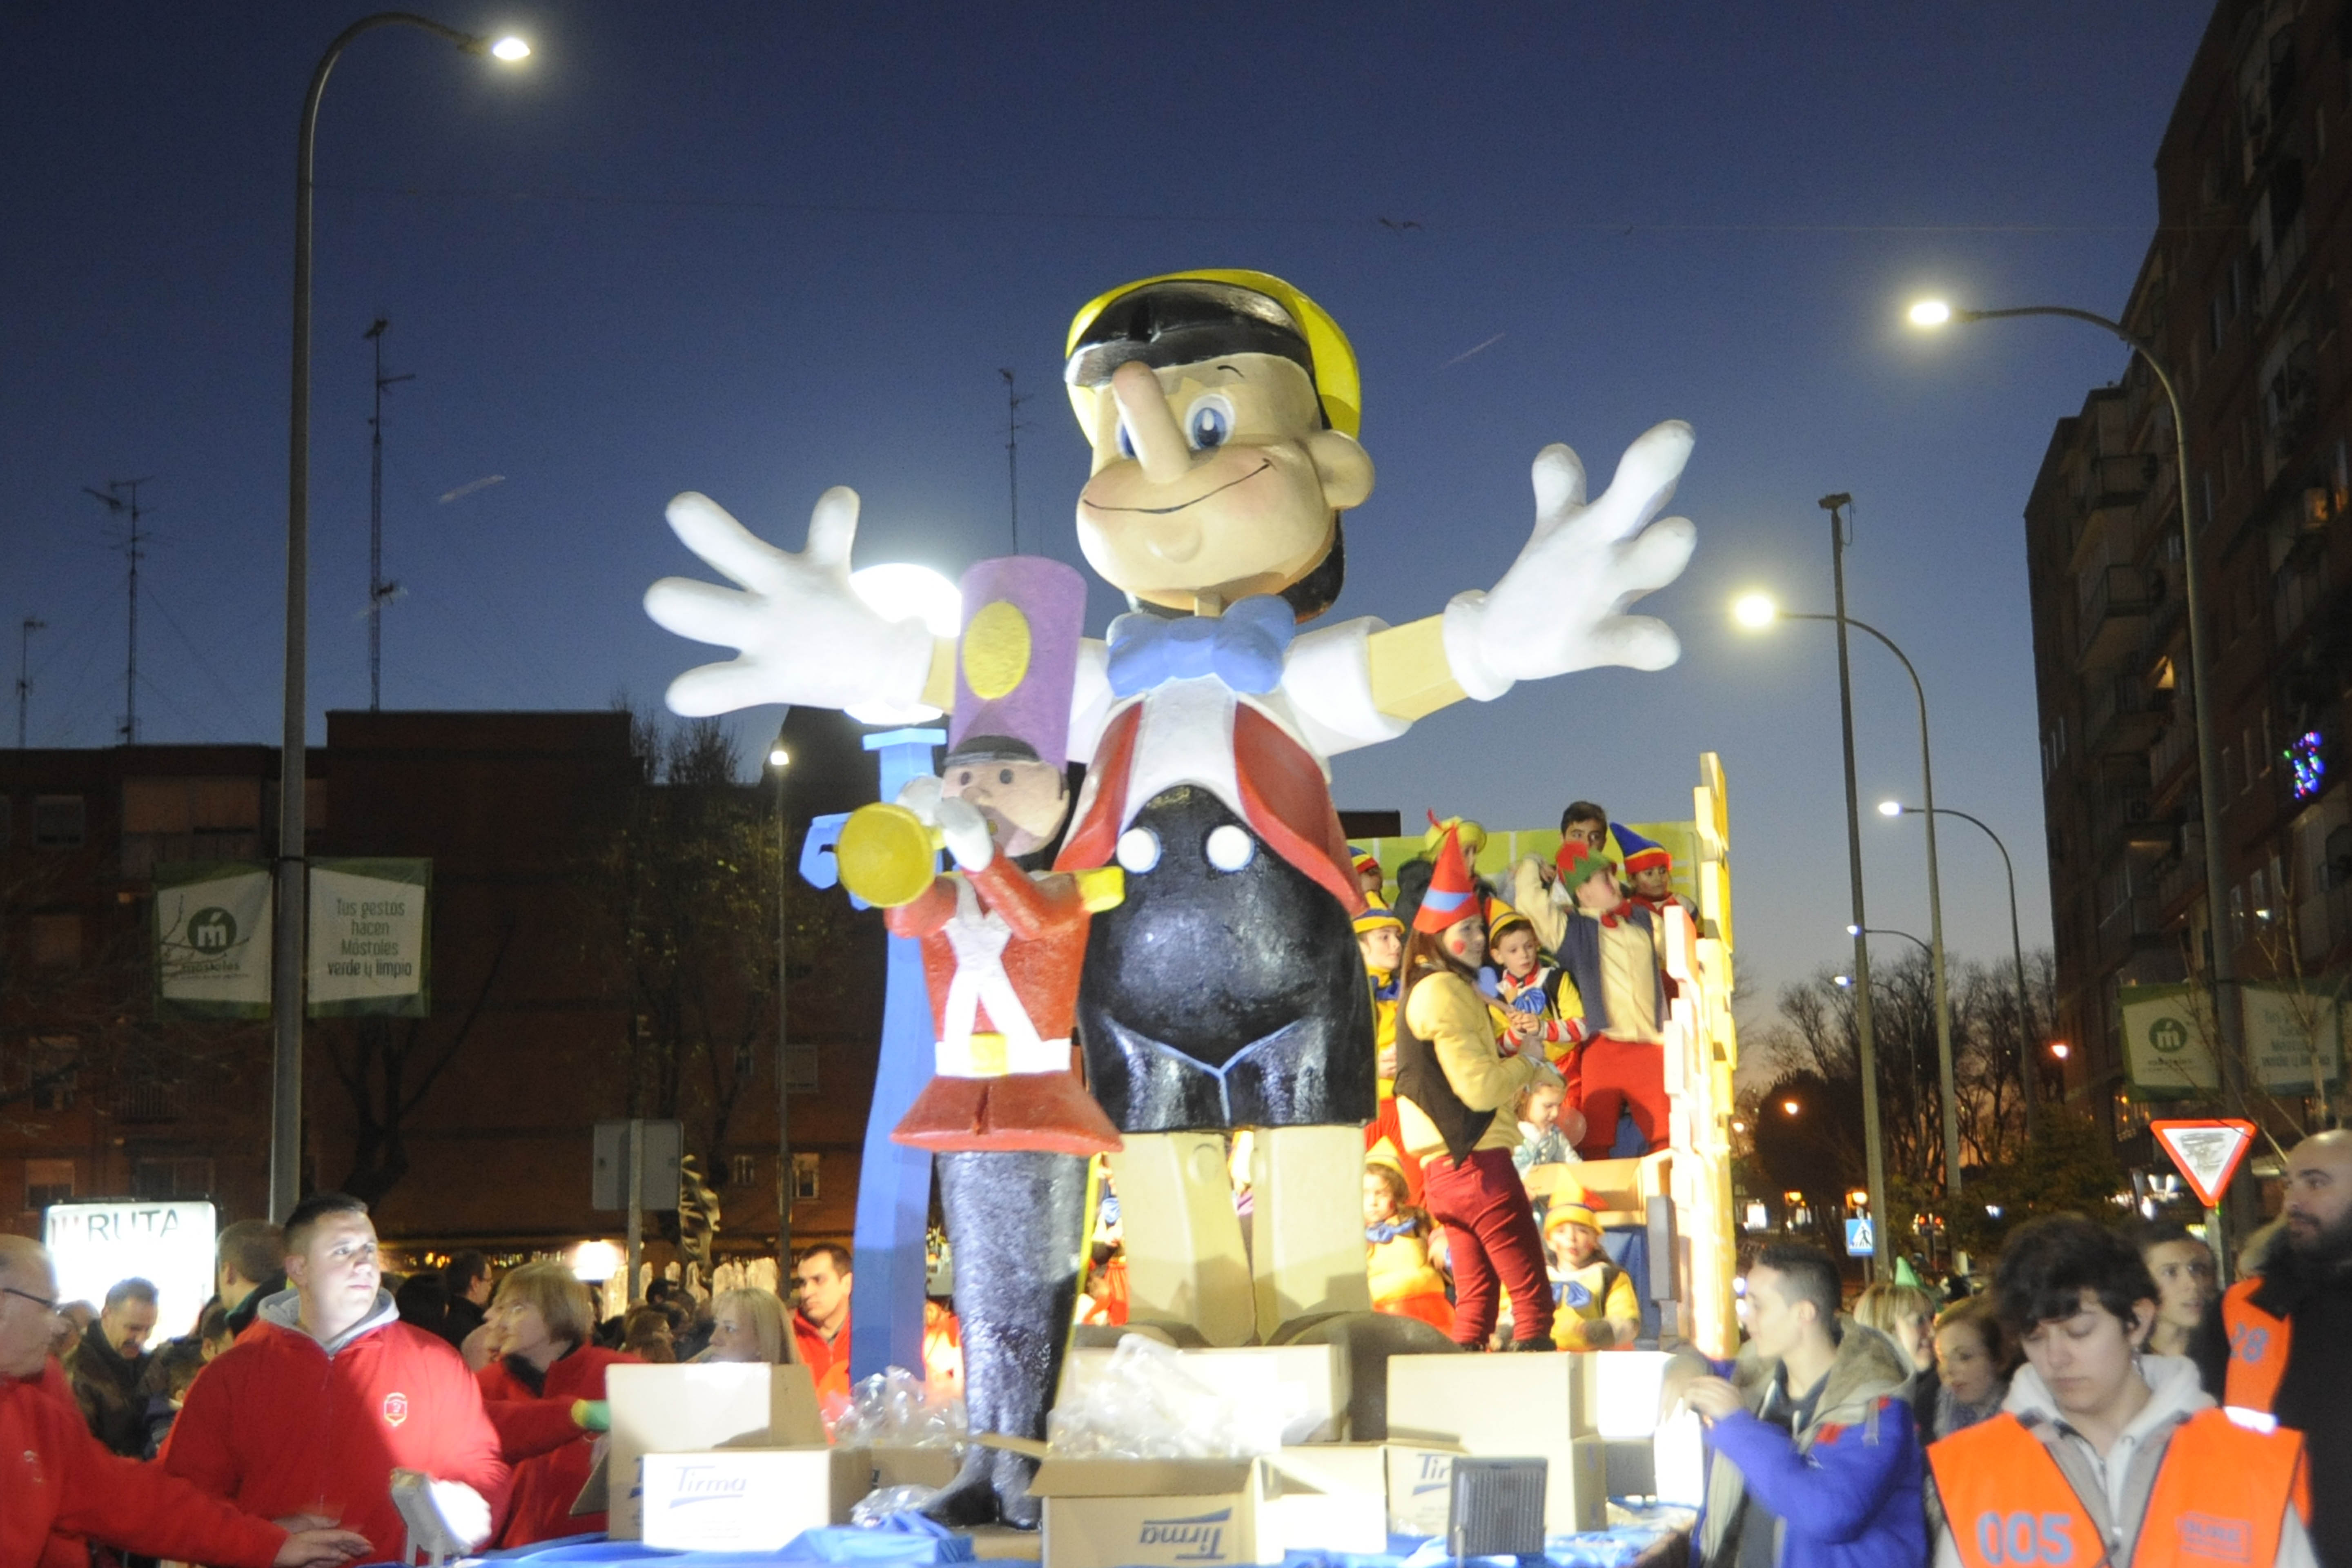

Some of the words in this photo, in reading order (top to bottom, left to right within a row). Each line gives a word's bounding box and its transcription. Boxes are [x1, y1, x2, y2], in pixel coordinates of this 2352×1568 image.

[336, 898, 356, 915] Tus
[361, 901, 405, 918] gestos
[351, 919, 390, 935] hacen
[341, 938, 399, 955] Móstoles
[327, 959, 361, 976] verde
[364, 962, 372, 978] y
[376, 959, 412, 978] limpio
[87, 1209, 179, 1242] RUTA
[676, 1465, 747, 1492] Tirma
[1417, 1453, 1451, 1479] Tir
[1140, 1527, 1225, 1559] Tirma
[1977, 1511, 2072, 1565] 005
